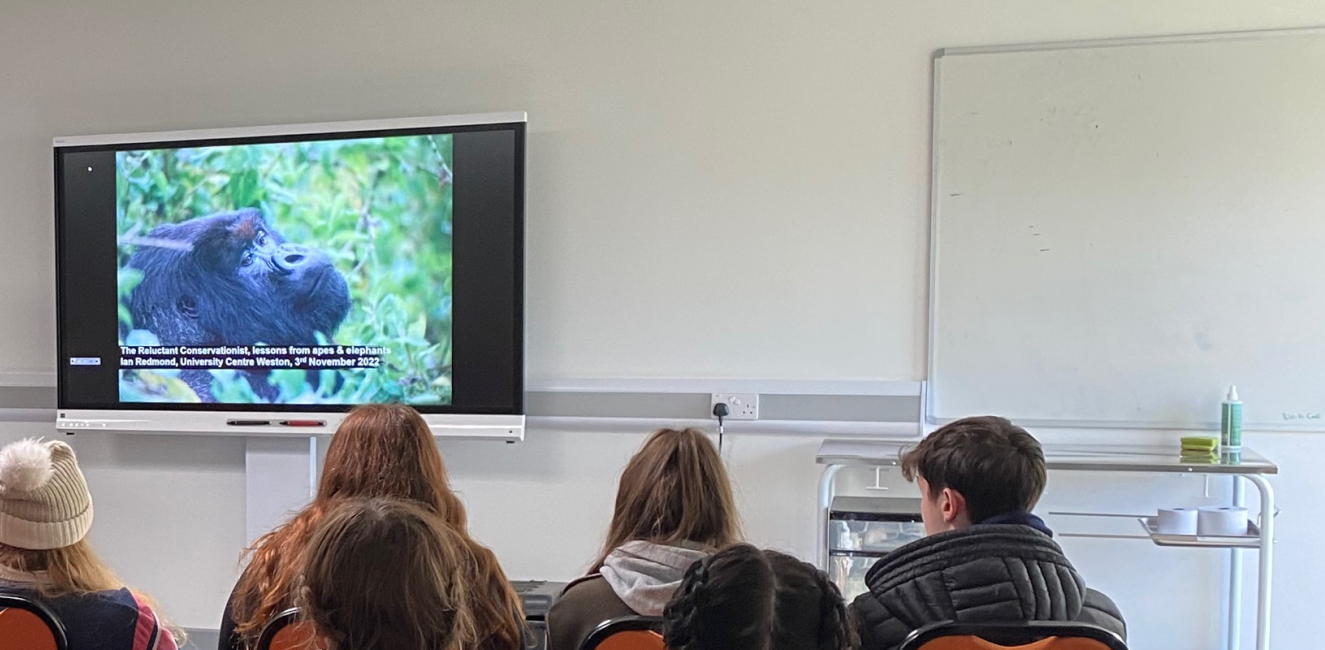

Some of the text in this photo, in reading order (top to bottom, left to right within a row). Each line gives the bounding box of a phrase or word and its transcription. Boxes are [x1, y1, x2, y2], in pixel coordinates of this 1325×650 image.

[120, 346, 392, 356] The Reluctant Conservationist, lessons from apes & elephants
[120, 356, 380, 367] Ian Redmond, University Centre Weston, 3rd November 2022
